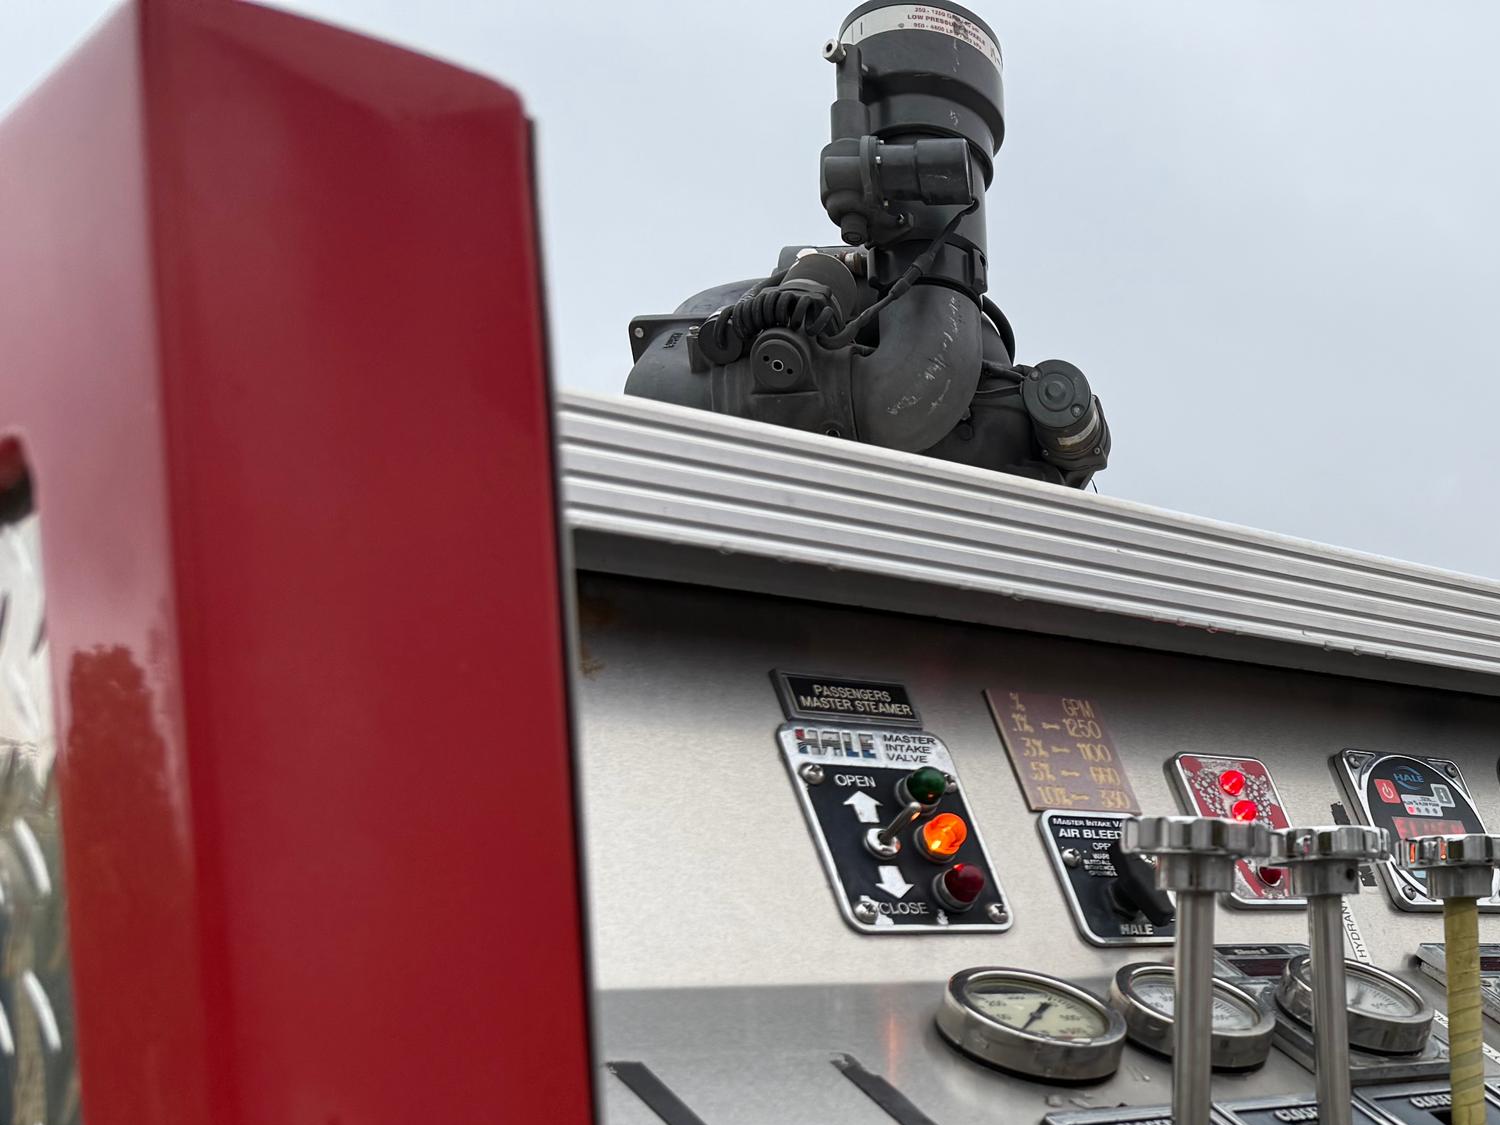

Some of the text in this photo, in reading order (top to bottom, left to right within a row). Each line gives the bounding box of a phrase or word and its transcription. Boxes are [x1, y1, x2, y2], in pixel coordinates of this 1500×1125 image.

[813, 684, 891, 702] PASSENGERS
[800, 696, 913, 716] MASTER STEAMER
[1062, 697, 1095, 719] GPM
[1062, 718, 1102, 739] 1250
[795, 728, 877, 758] HALE
[883, 734, 936, 745] MASTER
[885, 743, 932, 754] INTAKE
[887, 753, 929, 763] VALVE
[834, 774, 877, 787] OPEN
[1393, 773, 1425, 783] HALE
[1053, 818, 1085, 826] MASTER
[1059, 829, 1080, 838] AIR
[879, 901, 929, 915] CLOSE
[1120, 923, 1154, 935] HALE
[1410, 1093, 1451, 1109] CLOSE
[1275, 1108, 1319, 1122] CLOSE
